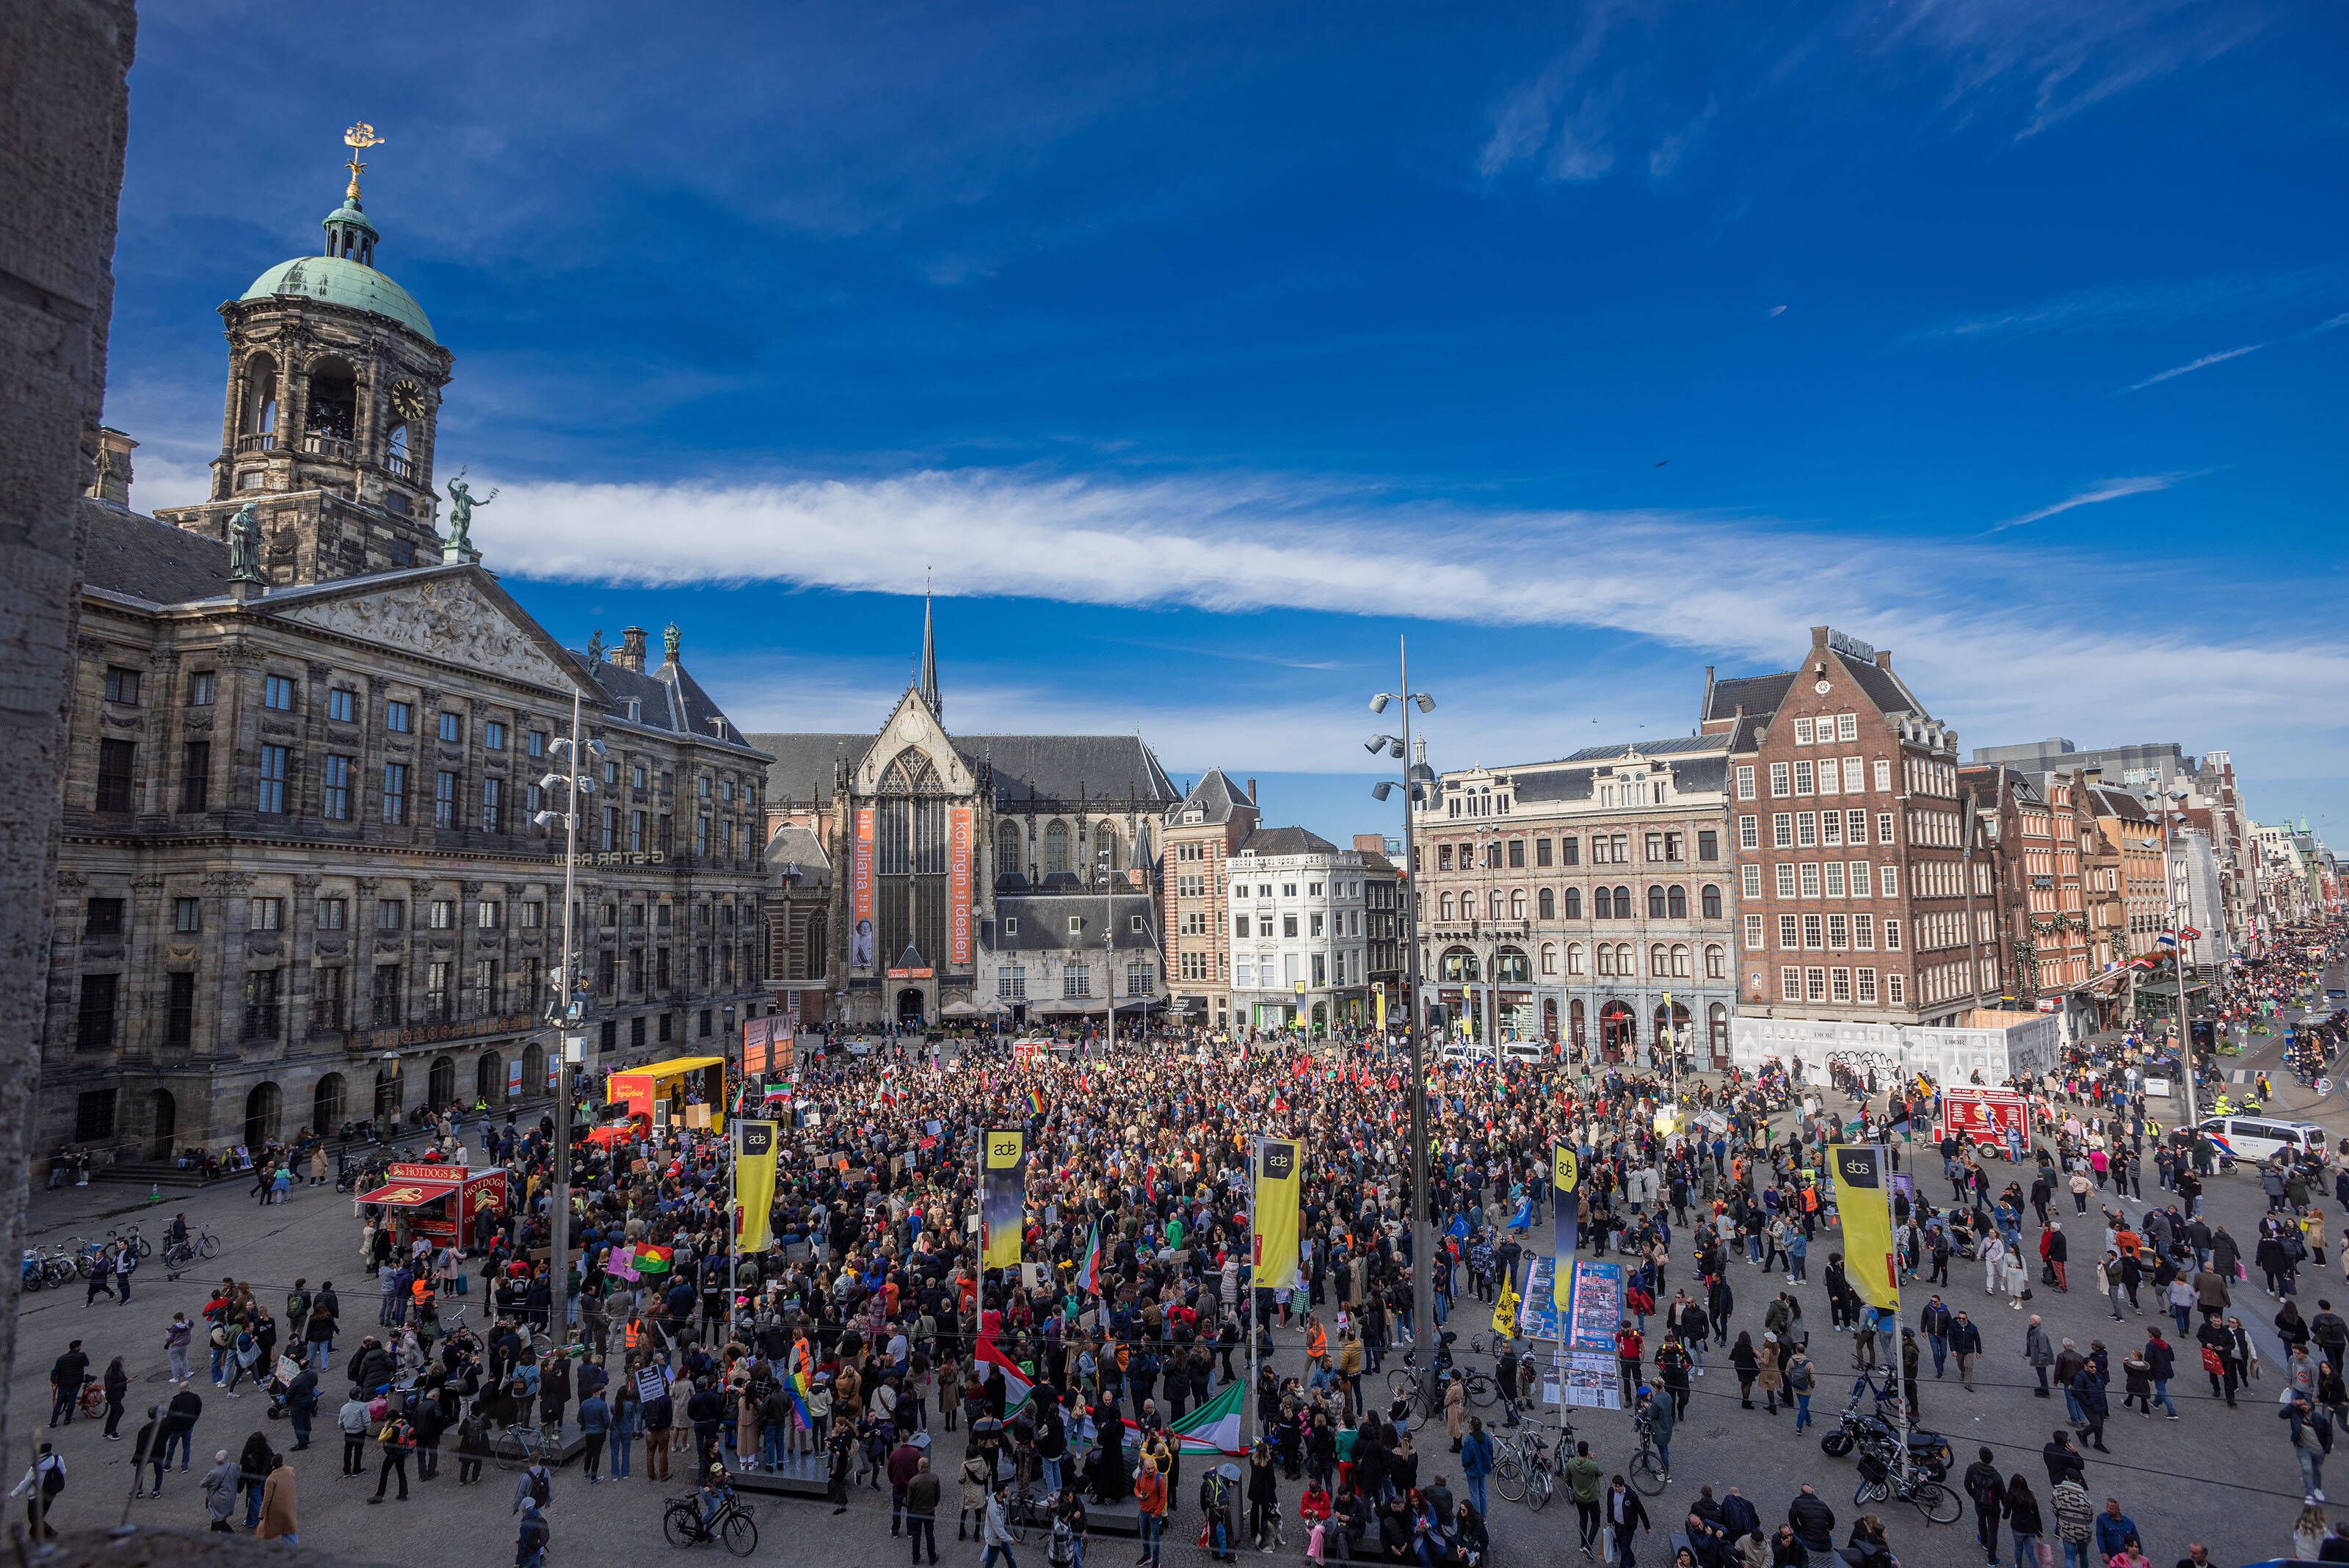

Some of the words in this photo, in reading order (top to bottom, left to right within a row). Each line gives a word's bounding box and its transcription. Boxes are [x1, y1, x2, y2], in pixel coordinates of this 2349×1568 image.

[857, 835, 871, 890] Juliana
[953, 821, 970, 886] koningin
[956, 904, 970, 960] idealen
[405, 1166, 449, 1179] HOTDOGS
[463, 1177, 505, 1199] HOTDOGS
